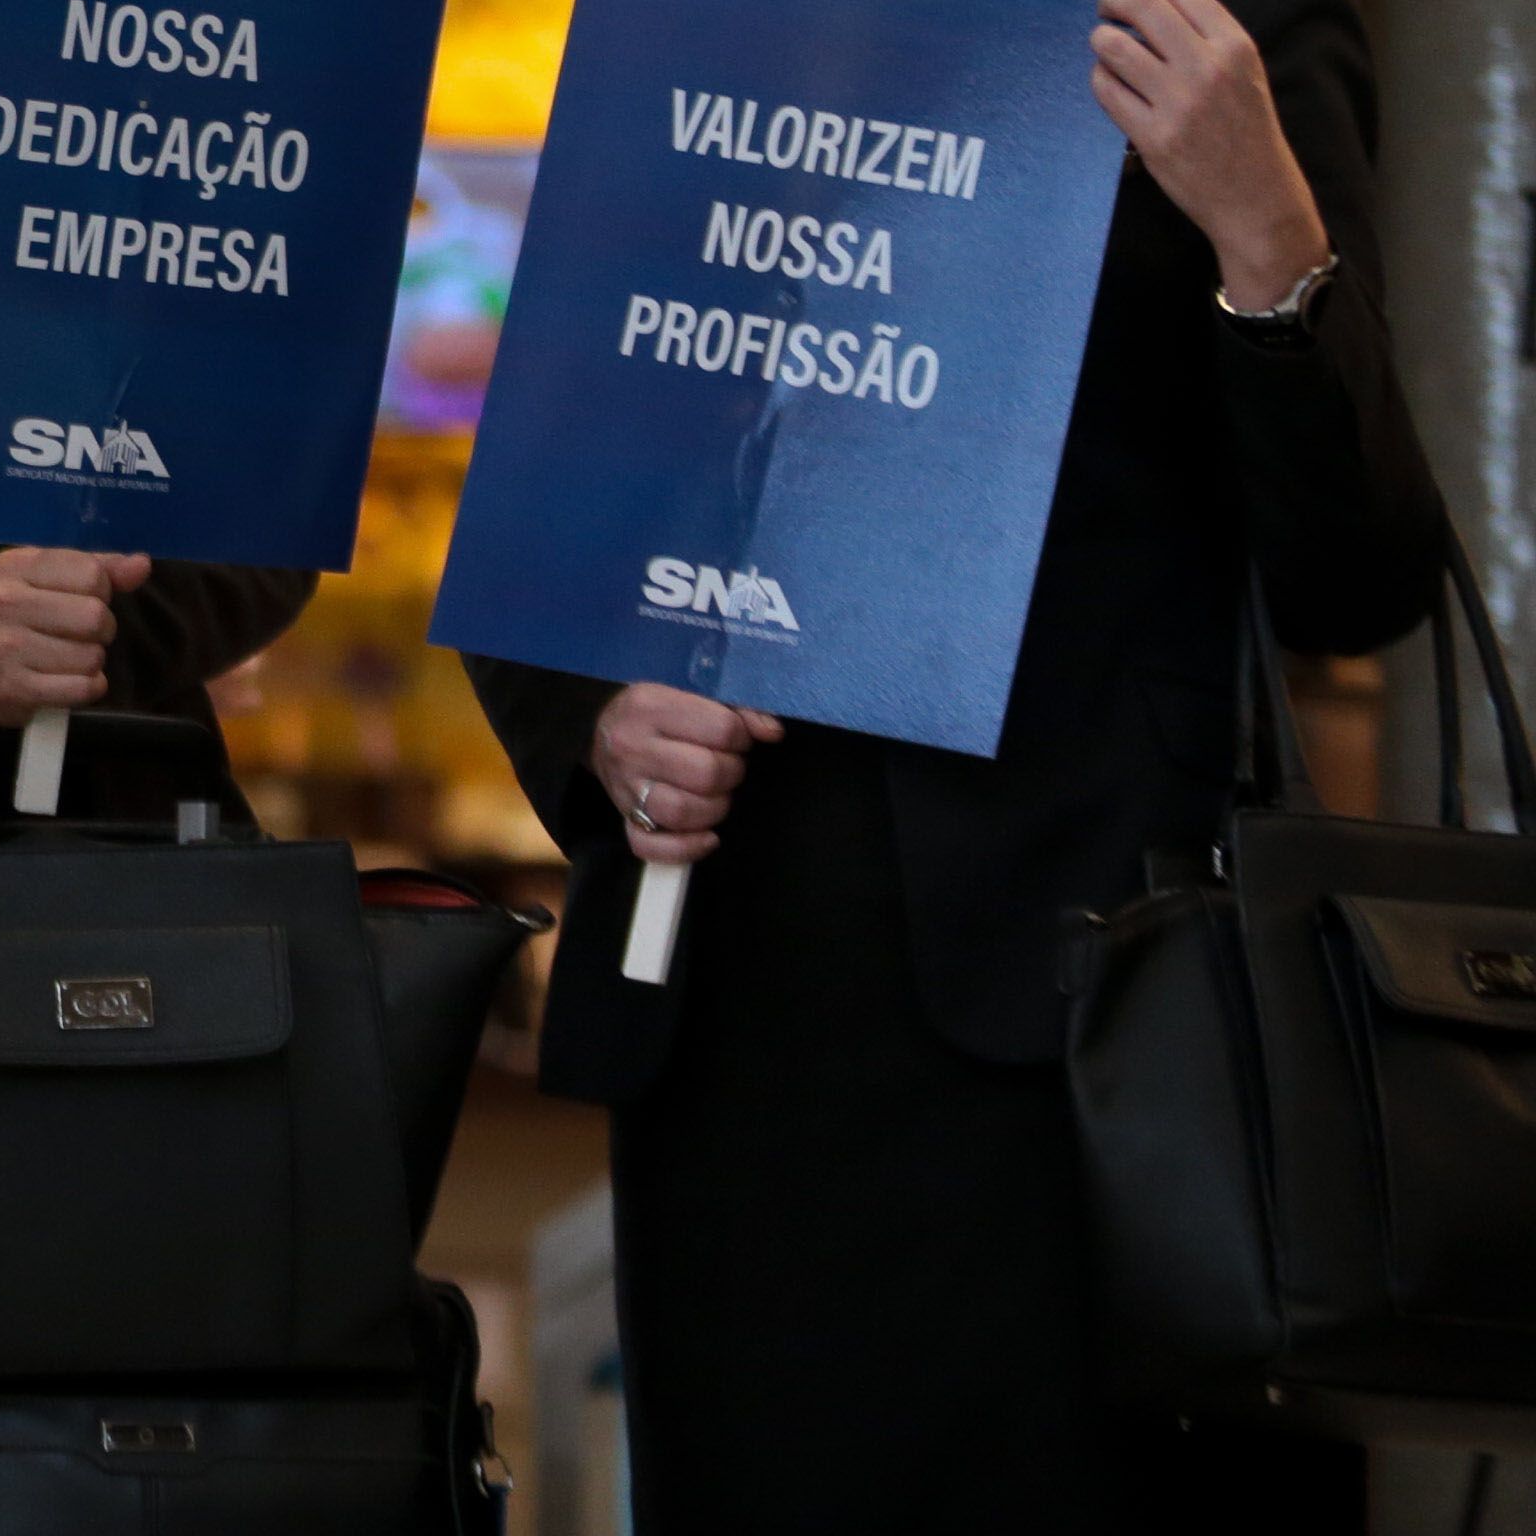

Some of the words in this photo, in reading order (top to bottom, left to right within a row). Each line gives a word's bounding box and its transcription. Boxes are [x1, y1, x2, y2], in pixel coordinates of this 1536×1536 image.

[674, 89, 985, 200] VALORIZEM
[16, 206, 288, 296] EMPRESA
[703, 202, 891, 294] NOSSA
[621, 295, 939, 409] PROFISSÃO
[9, 418, 171, 479] SNA
[641, 556, 801, 632] SNA
